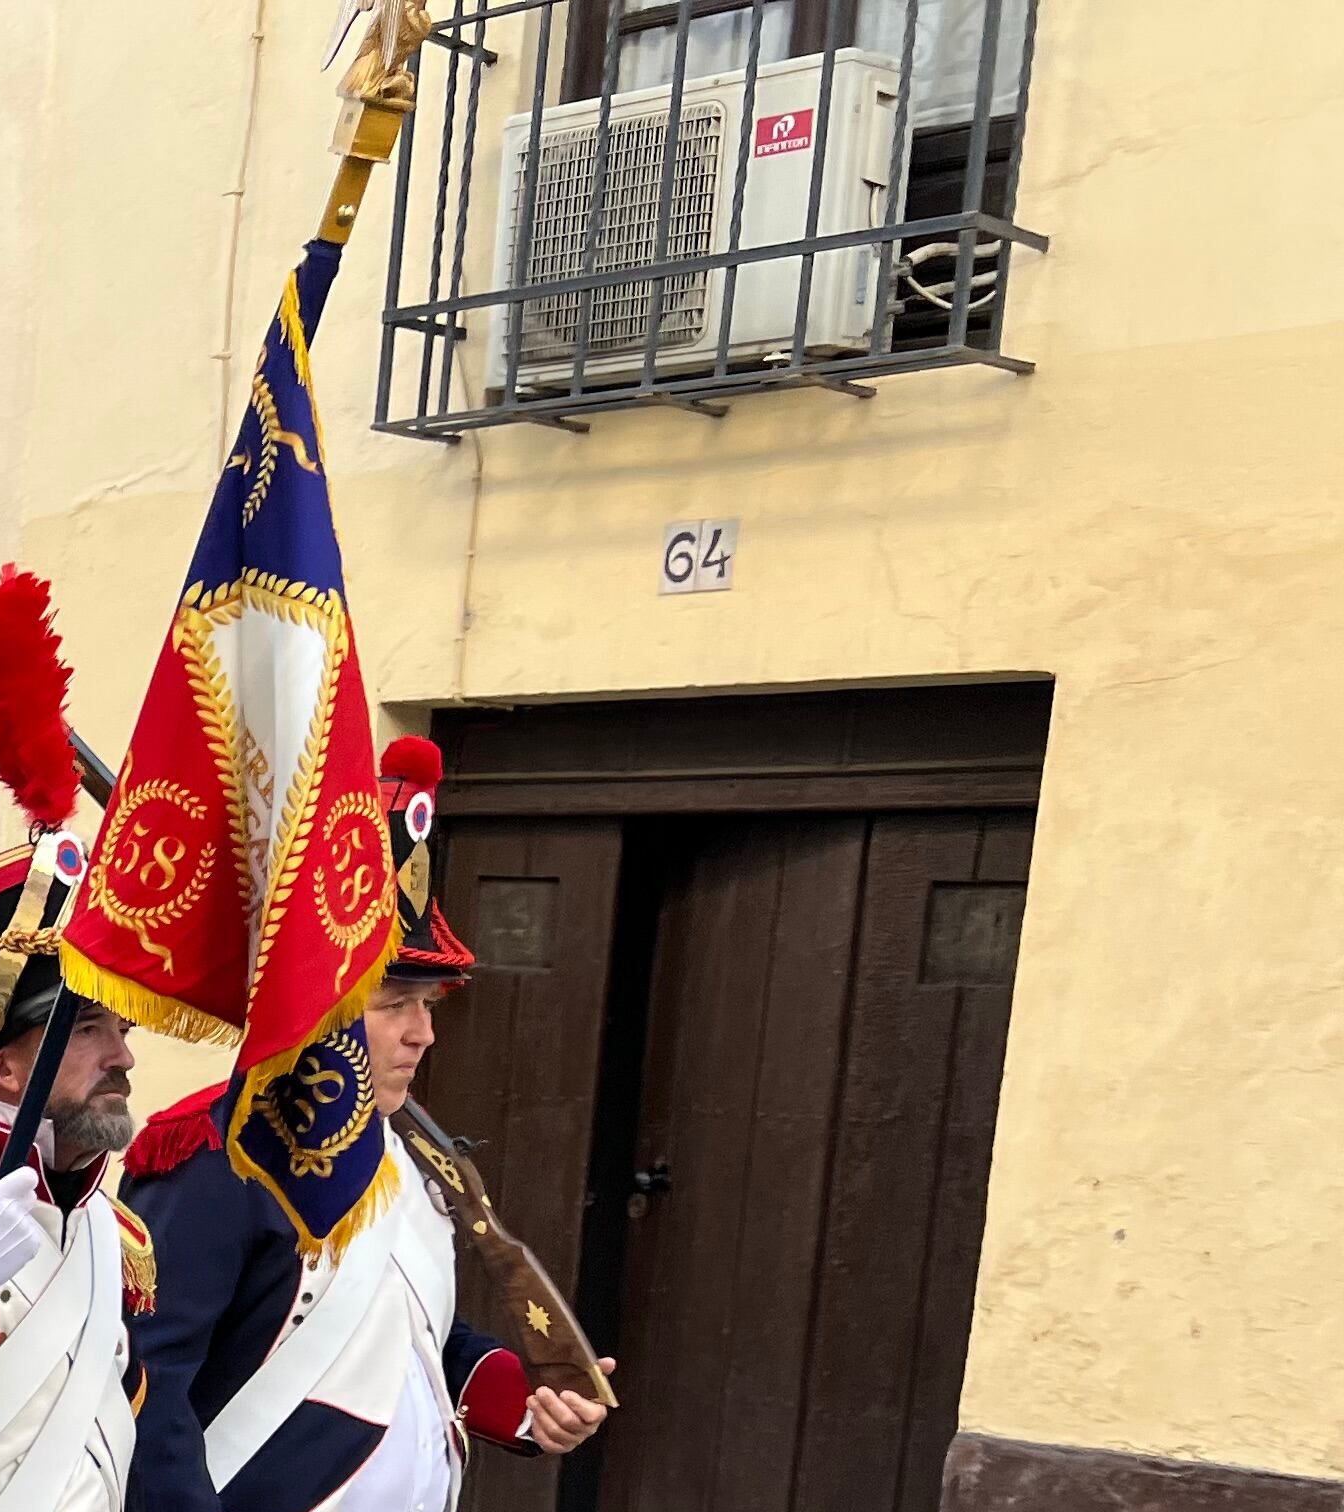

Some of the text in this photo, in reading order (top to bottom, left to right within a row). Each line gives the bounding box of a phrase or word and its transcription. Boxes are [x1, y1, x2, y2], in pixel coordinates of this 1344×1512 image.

[664, 528, 732, 583] 64
[115, 820, 186, 891] 58
[332, 827, 373, 912] 58
